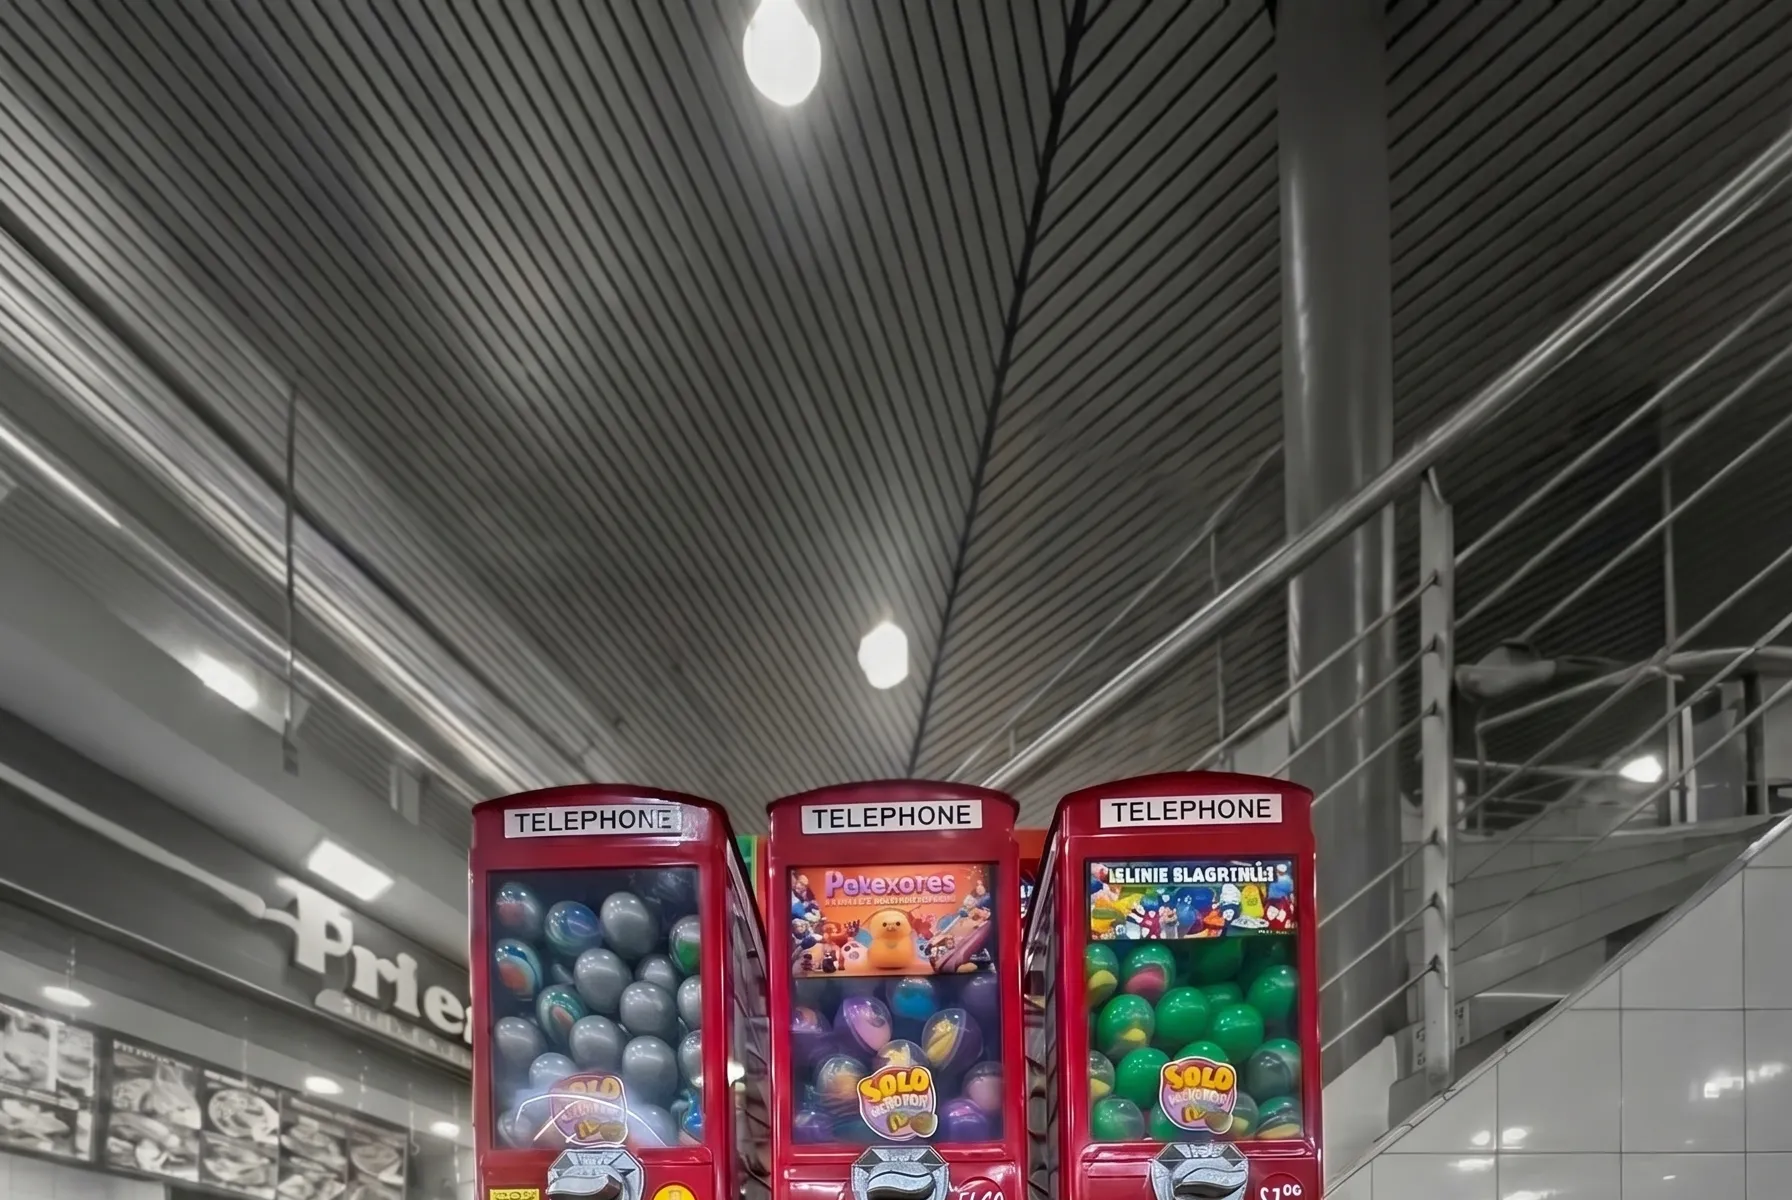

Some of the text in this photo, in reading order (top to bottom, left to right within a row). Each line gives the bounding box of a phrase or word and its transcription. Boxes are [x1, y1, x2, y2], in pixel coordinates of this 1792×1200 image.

[514, 809, 671, 833] TELEPHONE
[812, 804, 971, 829] TELEPHONE
[1112, 798, 1271, 822] TELEPHONE
[275, 876, 473, 1044] Prie
[860, 1067, 930, 1103] SOLO
[1164, 1064, 1234, 1091] SOLO
